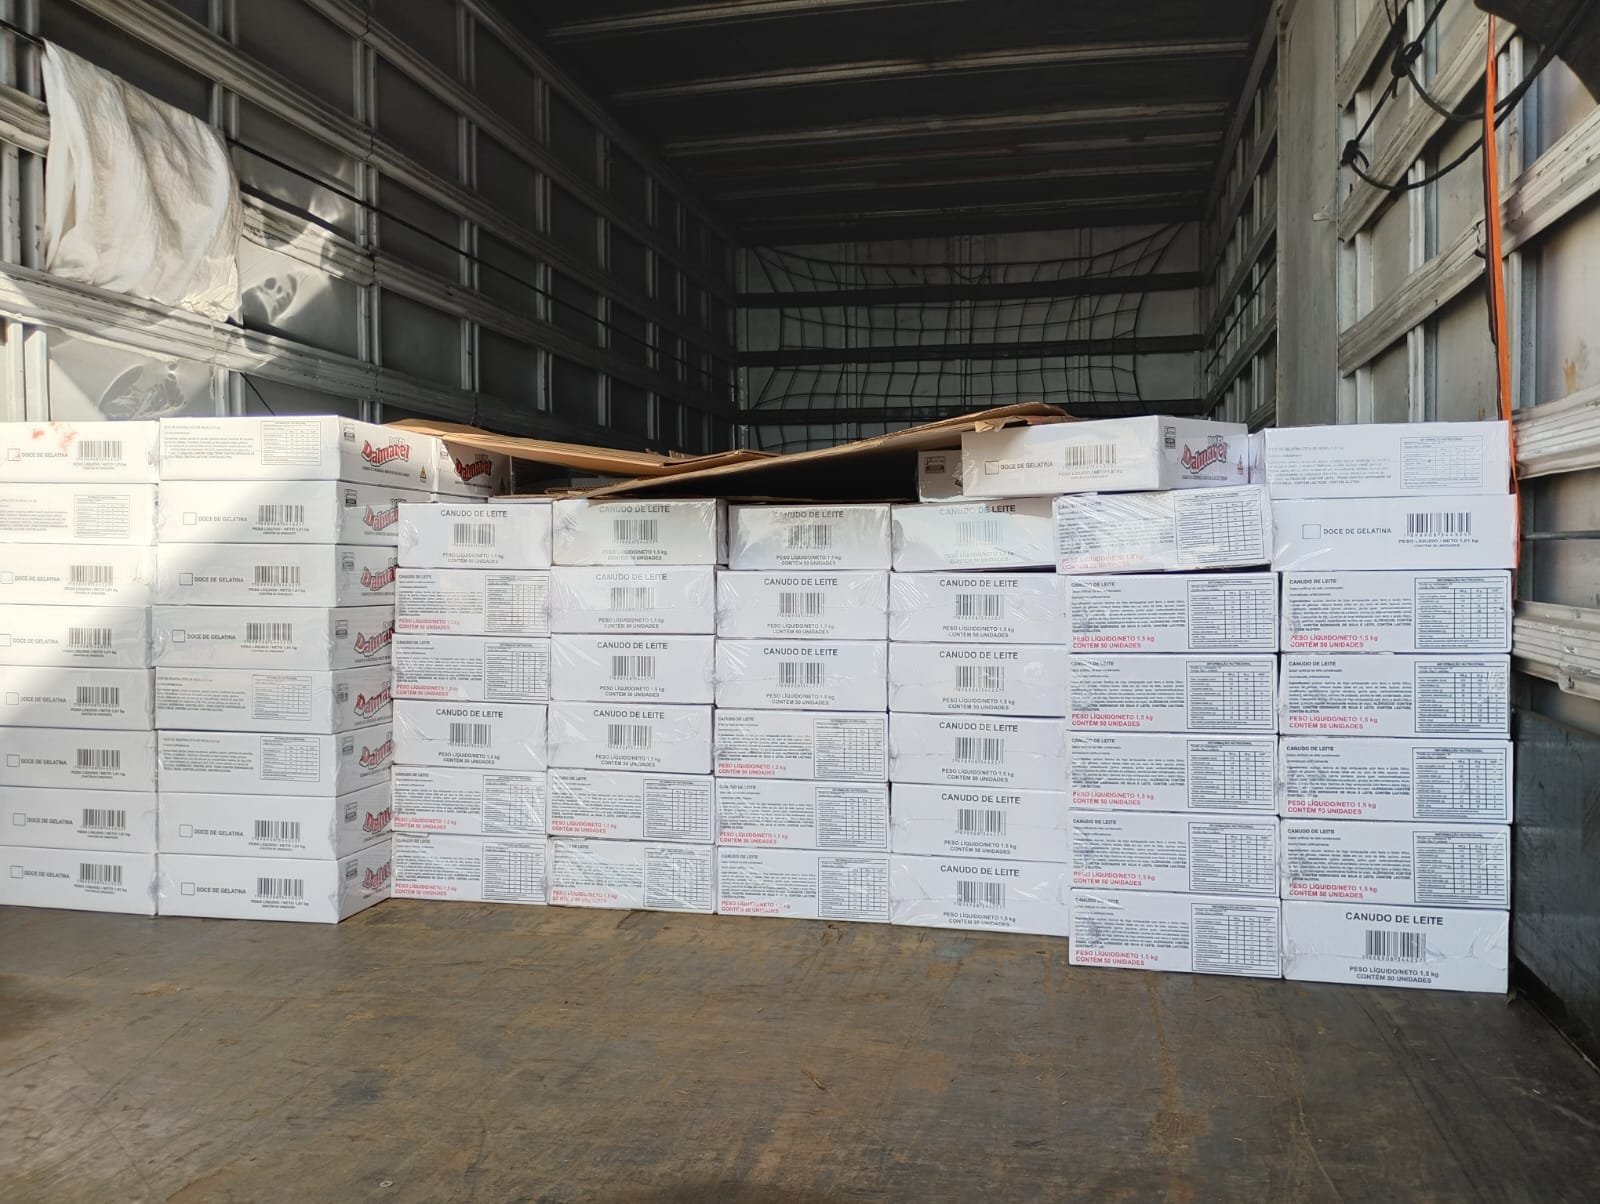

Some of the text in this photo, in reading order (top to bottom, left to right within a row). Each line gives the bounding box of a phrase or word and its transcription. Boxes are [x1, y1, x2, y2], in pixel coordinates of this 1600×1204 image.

[648, 505, 670, 513] LEITE
[992, 504, 1016, 513] LEITE
[440, 509, 472, 517] CANUDO
[486, 510, 508, 518] LEITE
[822, 510, 844, 518] LEITE
[764, 578, 838, 586] CANUDO DE LEITE
[939, 579, 977, 587] CANUDO
[993, 580, 1019, 588] LEITE
[597, 641, 631, 649] CANUDO
[646, 642, 669, 650] LEITE
[763, 648, 838, 656] CANUDO DE LEITE
[939, 651, 1019, 660] CANUDO DE LEITE
[436, 708, 468, 717] CANUDO
[482, 710, 503, 718] LEITE
[593, 710, 665, 720] CANUDO DE LEITE
[939, 722, 1019, 733] CANUDO DE LEITE
[941, 793, 1021, 805] CANUDO DE LEITE
[940, 865, 1020, 877] CANUDO DE LEITE
[1345, 912, 1444, 926] CANUDO DE LEITE
